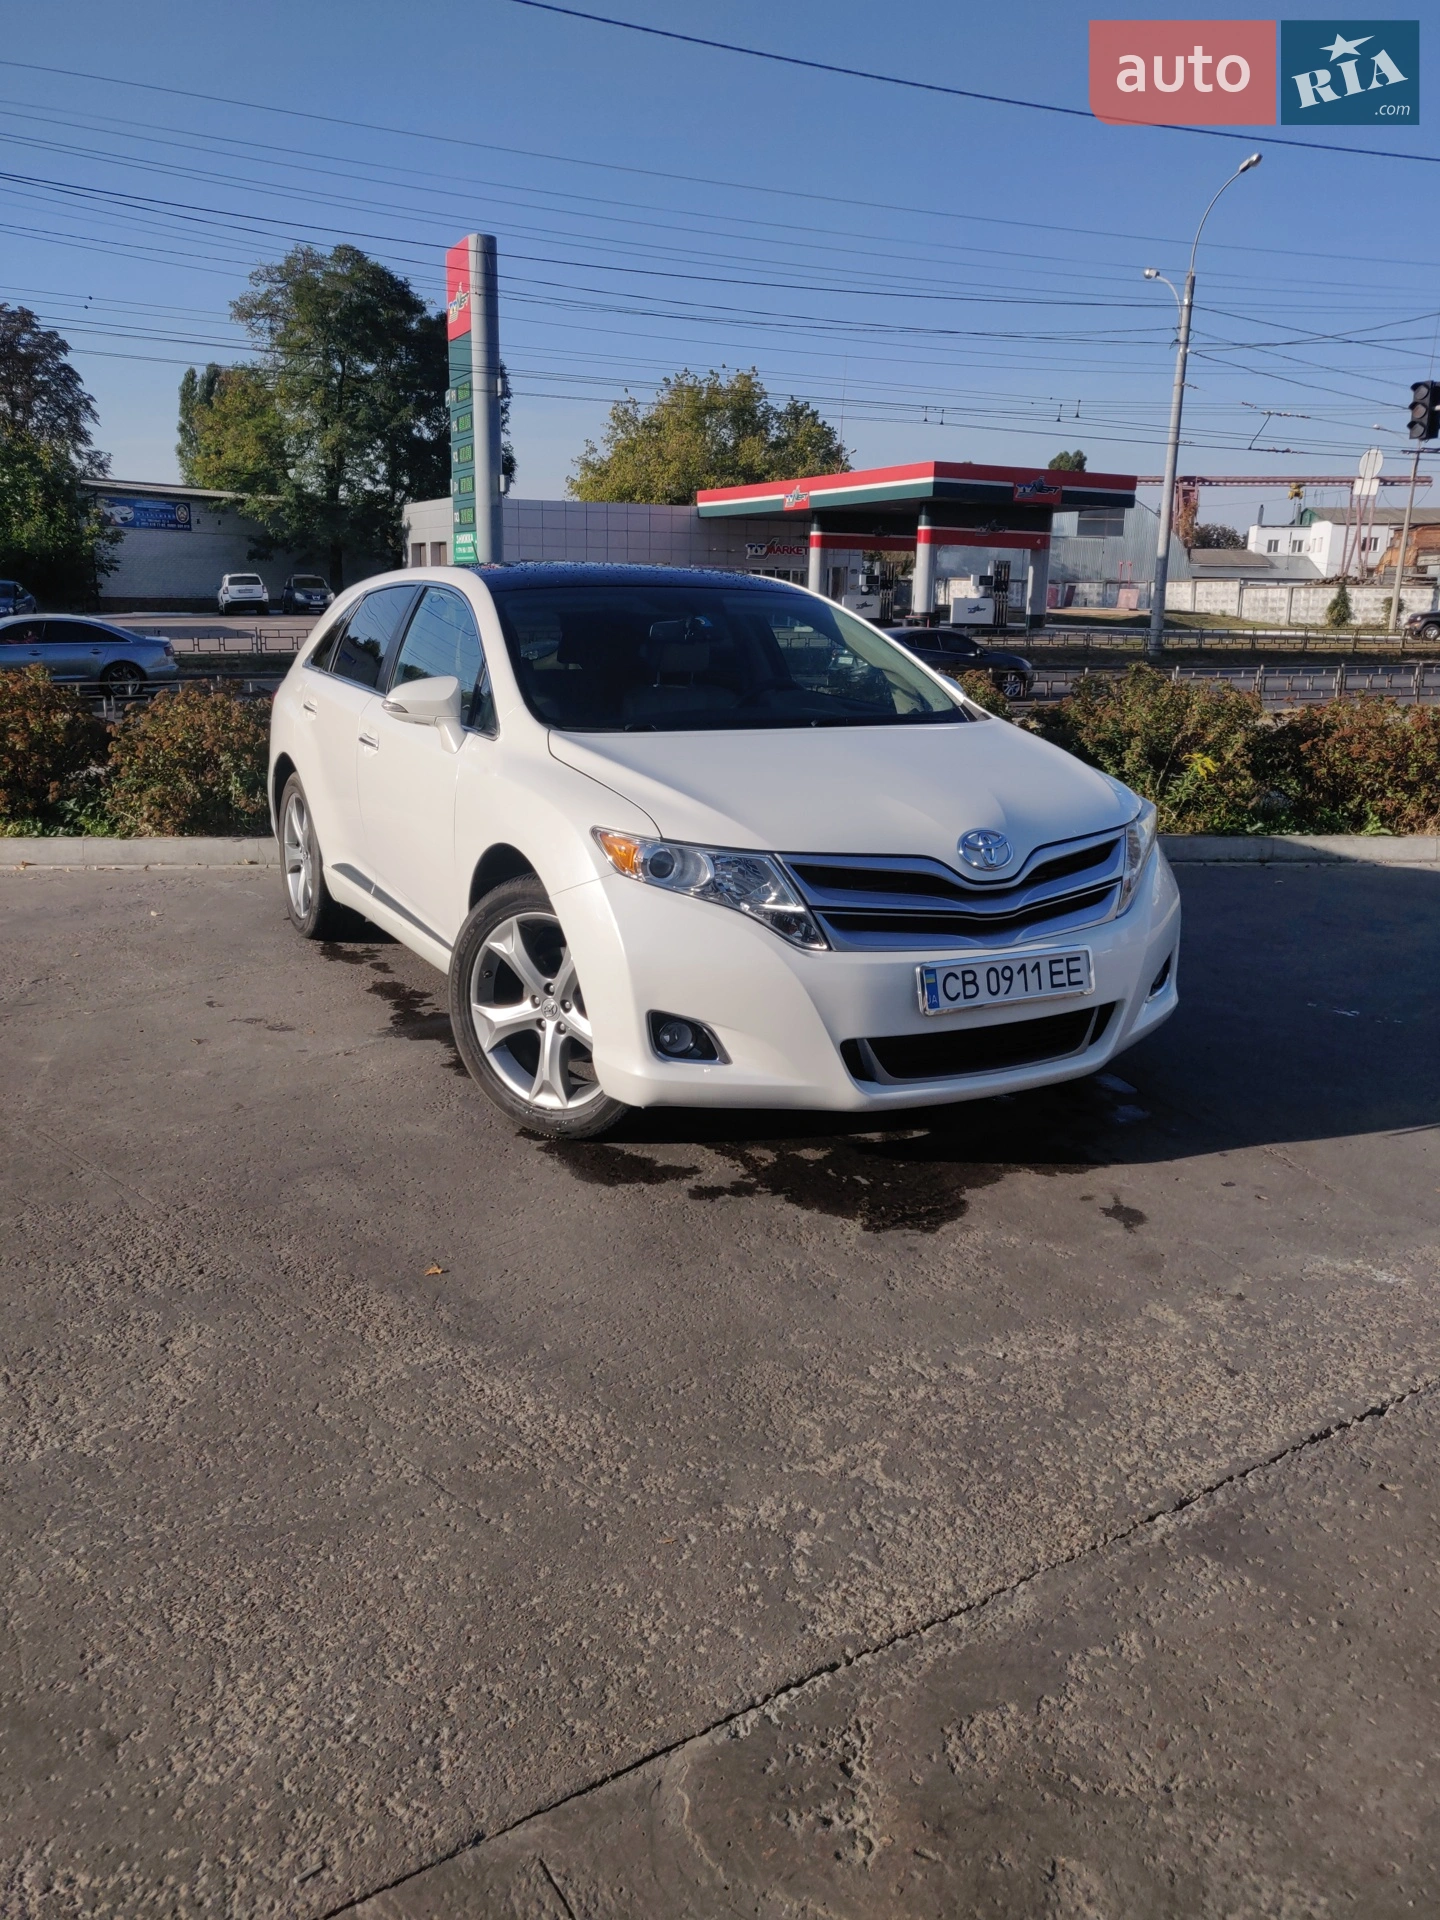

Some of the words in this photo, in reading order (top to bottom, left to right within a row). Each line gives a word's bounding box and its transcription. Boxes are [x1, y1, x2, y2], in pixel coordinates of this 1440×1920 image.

[942, 970, 980, 1002] CB
[985, 961, 1043, 997] 0911
[1048, 956, 1084, 989] EE
